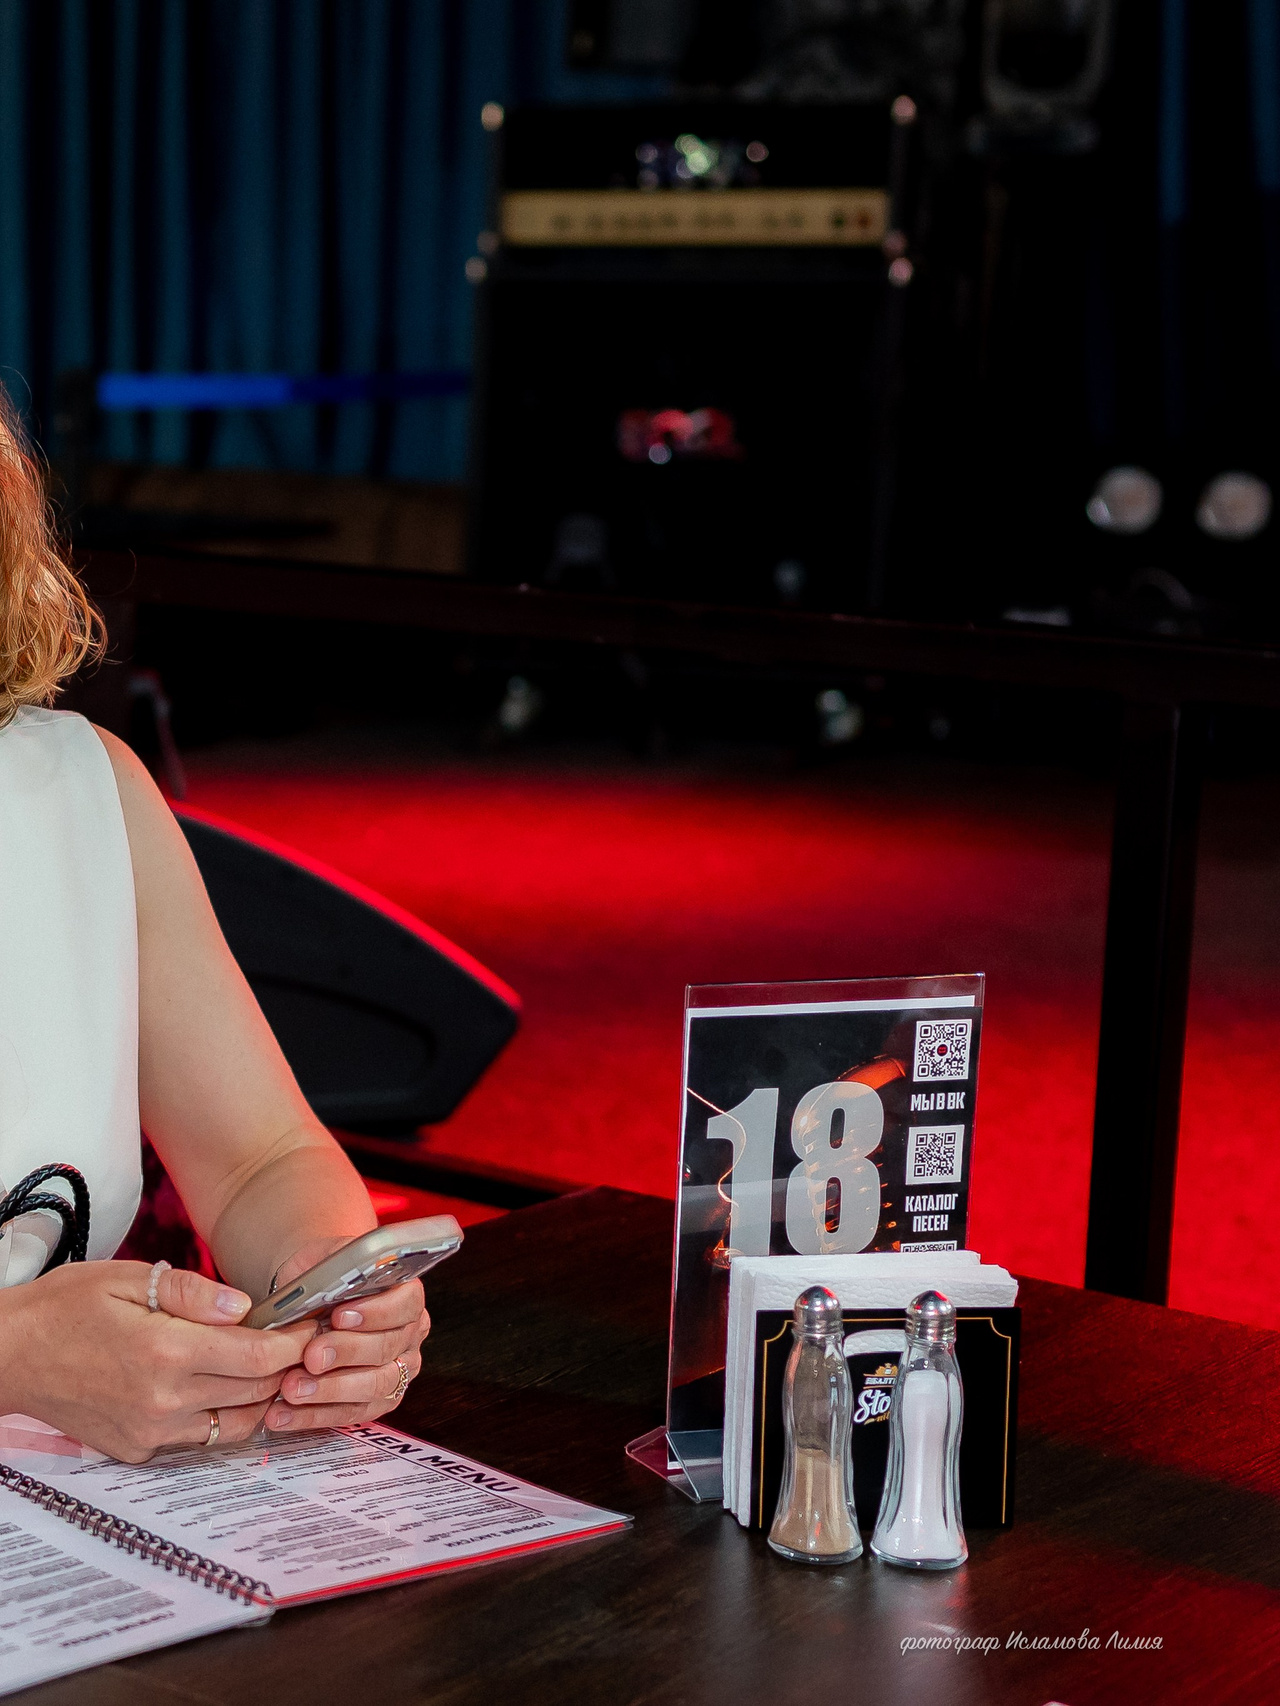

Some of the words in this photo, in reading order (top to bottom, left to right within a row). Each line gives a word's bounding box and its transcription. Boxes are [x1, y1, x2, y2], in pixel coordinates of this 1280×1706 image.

[910, 1093, 935, 1111] МЫ
[936, 1092, 945, 1110] В
[947, 1092, 965, 1110] ВК
[707, 1081, 884, 1256] 18
[905, 1194, 958, 1212] КАТАЛОГ
[913, 1214, 949, 1232] ПЕСЕН
[853, 1389, 891, 1423] Sto
[417, 1455, 520, 1492] MENU
